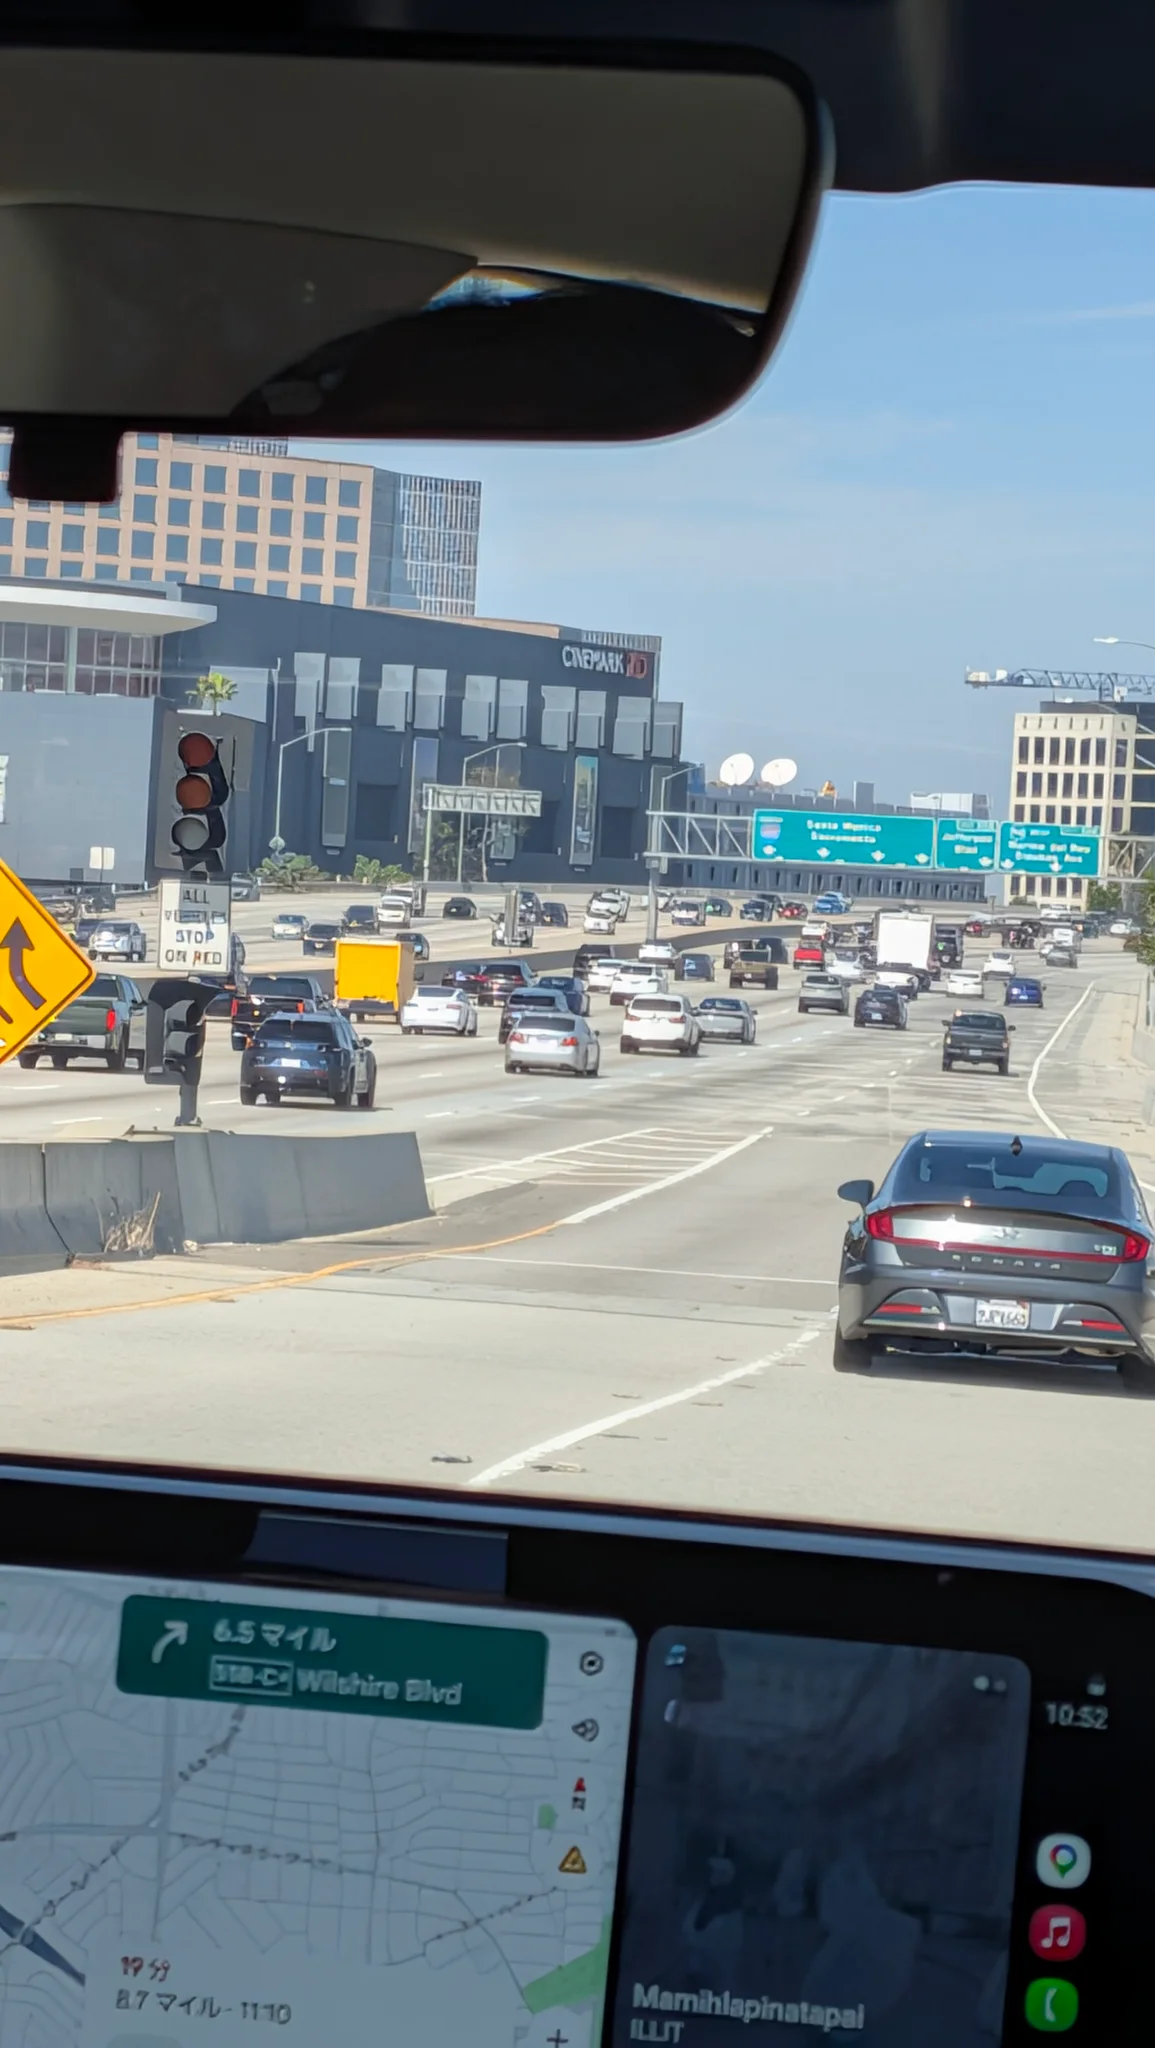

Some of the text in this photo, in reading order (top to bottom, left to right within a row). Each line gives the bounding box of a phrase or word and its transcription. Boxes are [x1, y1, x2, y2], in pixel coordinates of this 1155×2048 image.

[183, 888, 210, 905] ALL
[176, 928, 215, 945] STOP
[165, 949, 222, 967] ON RED
[213, 1618, 337, 1652] 6.5 マイル
[296, 1668, 400, 1701] Wilshire
[405, 1678, 464, 1706] Blvd
[1045, 1702, 1109, 1730] 10:52
[116, 1988, 150, 2011] 87
[156, 1992, 222, 2019] マイル
[241, 2001, 292, 2026] 1110
[630, 2018, 685, 2044] ILLIT
